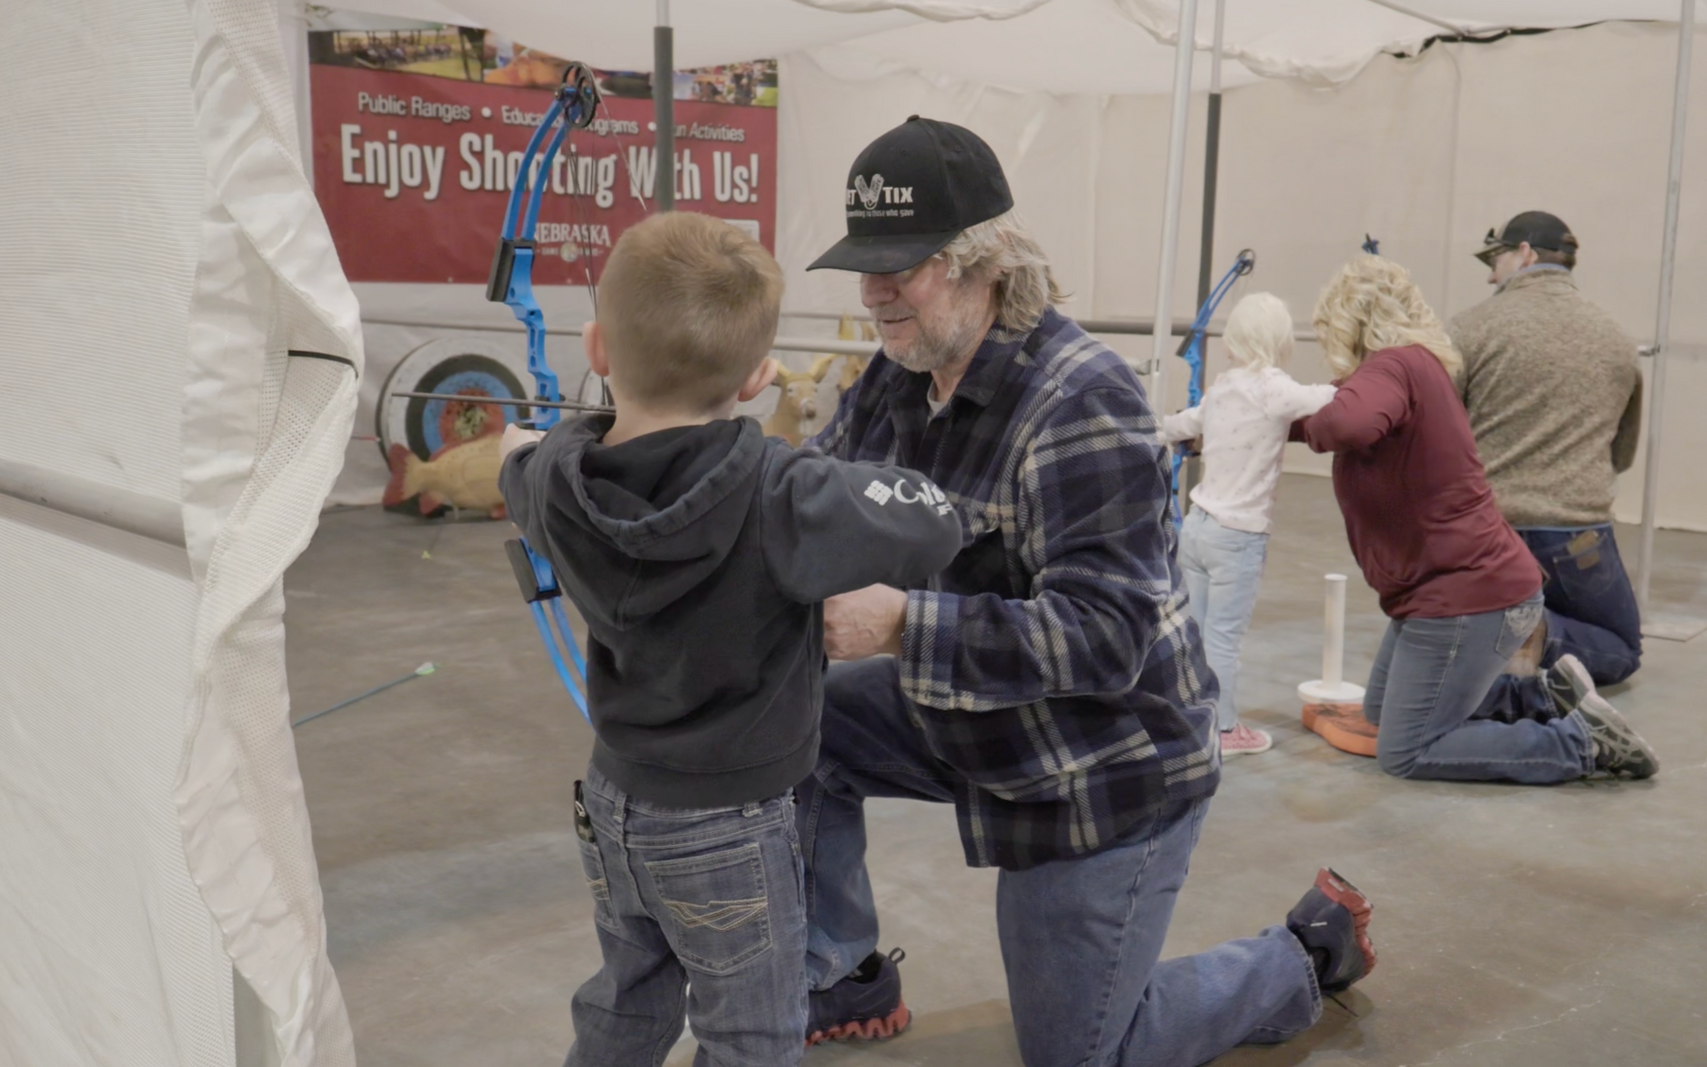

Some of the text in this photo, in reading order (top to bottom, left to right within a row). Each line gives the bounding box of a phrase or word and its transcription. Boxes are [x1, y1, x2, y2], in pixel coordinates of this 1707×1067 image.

[358, 91, 406, 115] Public
[411, 97, 471, 122] Ranges
[689, 121, 745, 142] Activities
[341, 123, 445, 200] Enjoy
[629, 145, 702, 200] Wth
[713, 151, 759, 203] Us!
[882, 186, 913, 203] TIX
[534, 222, 612, 248] NEBRASKA
